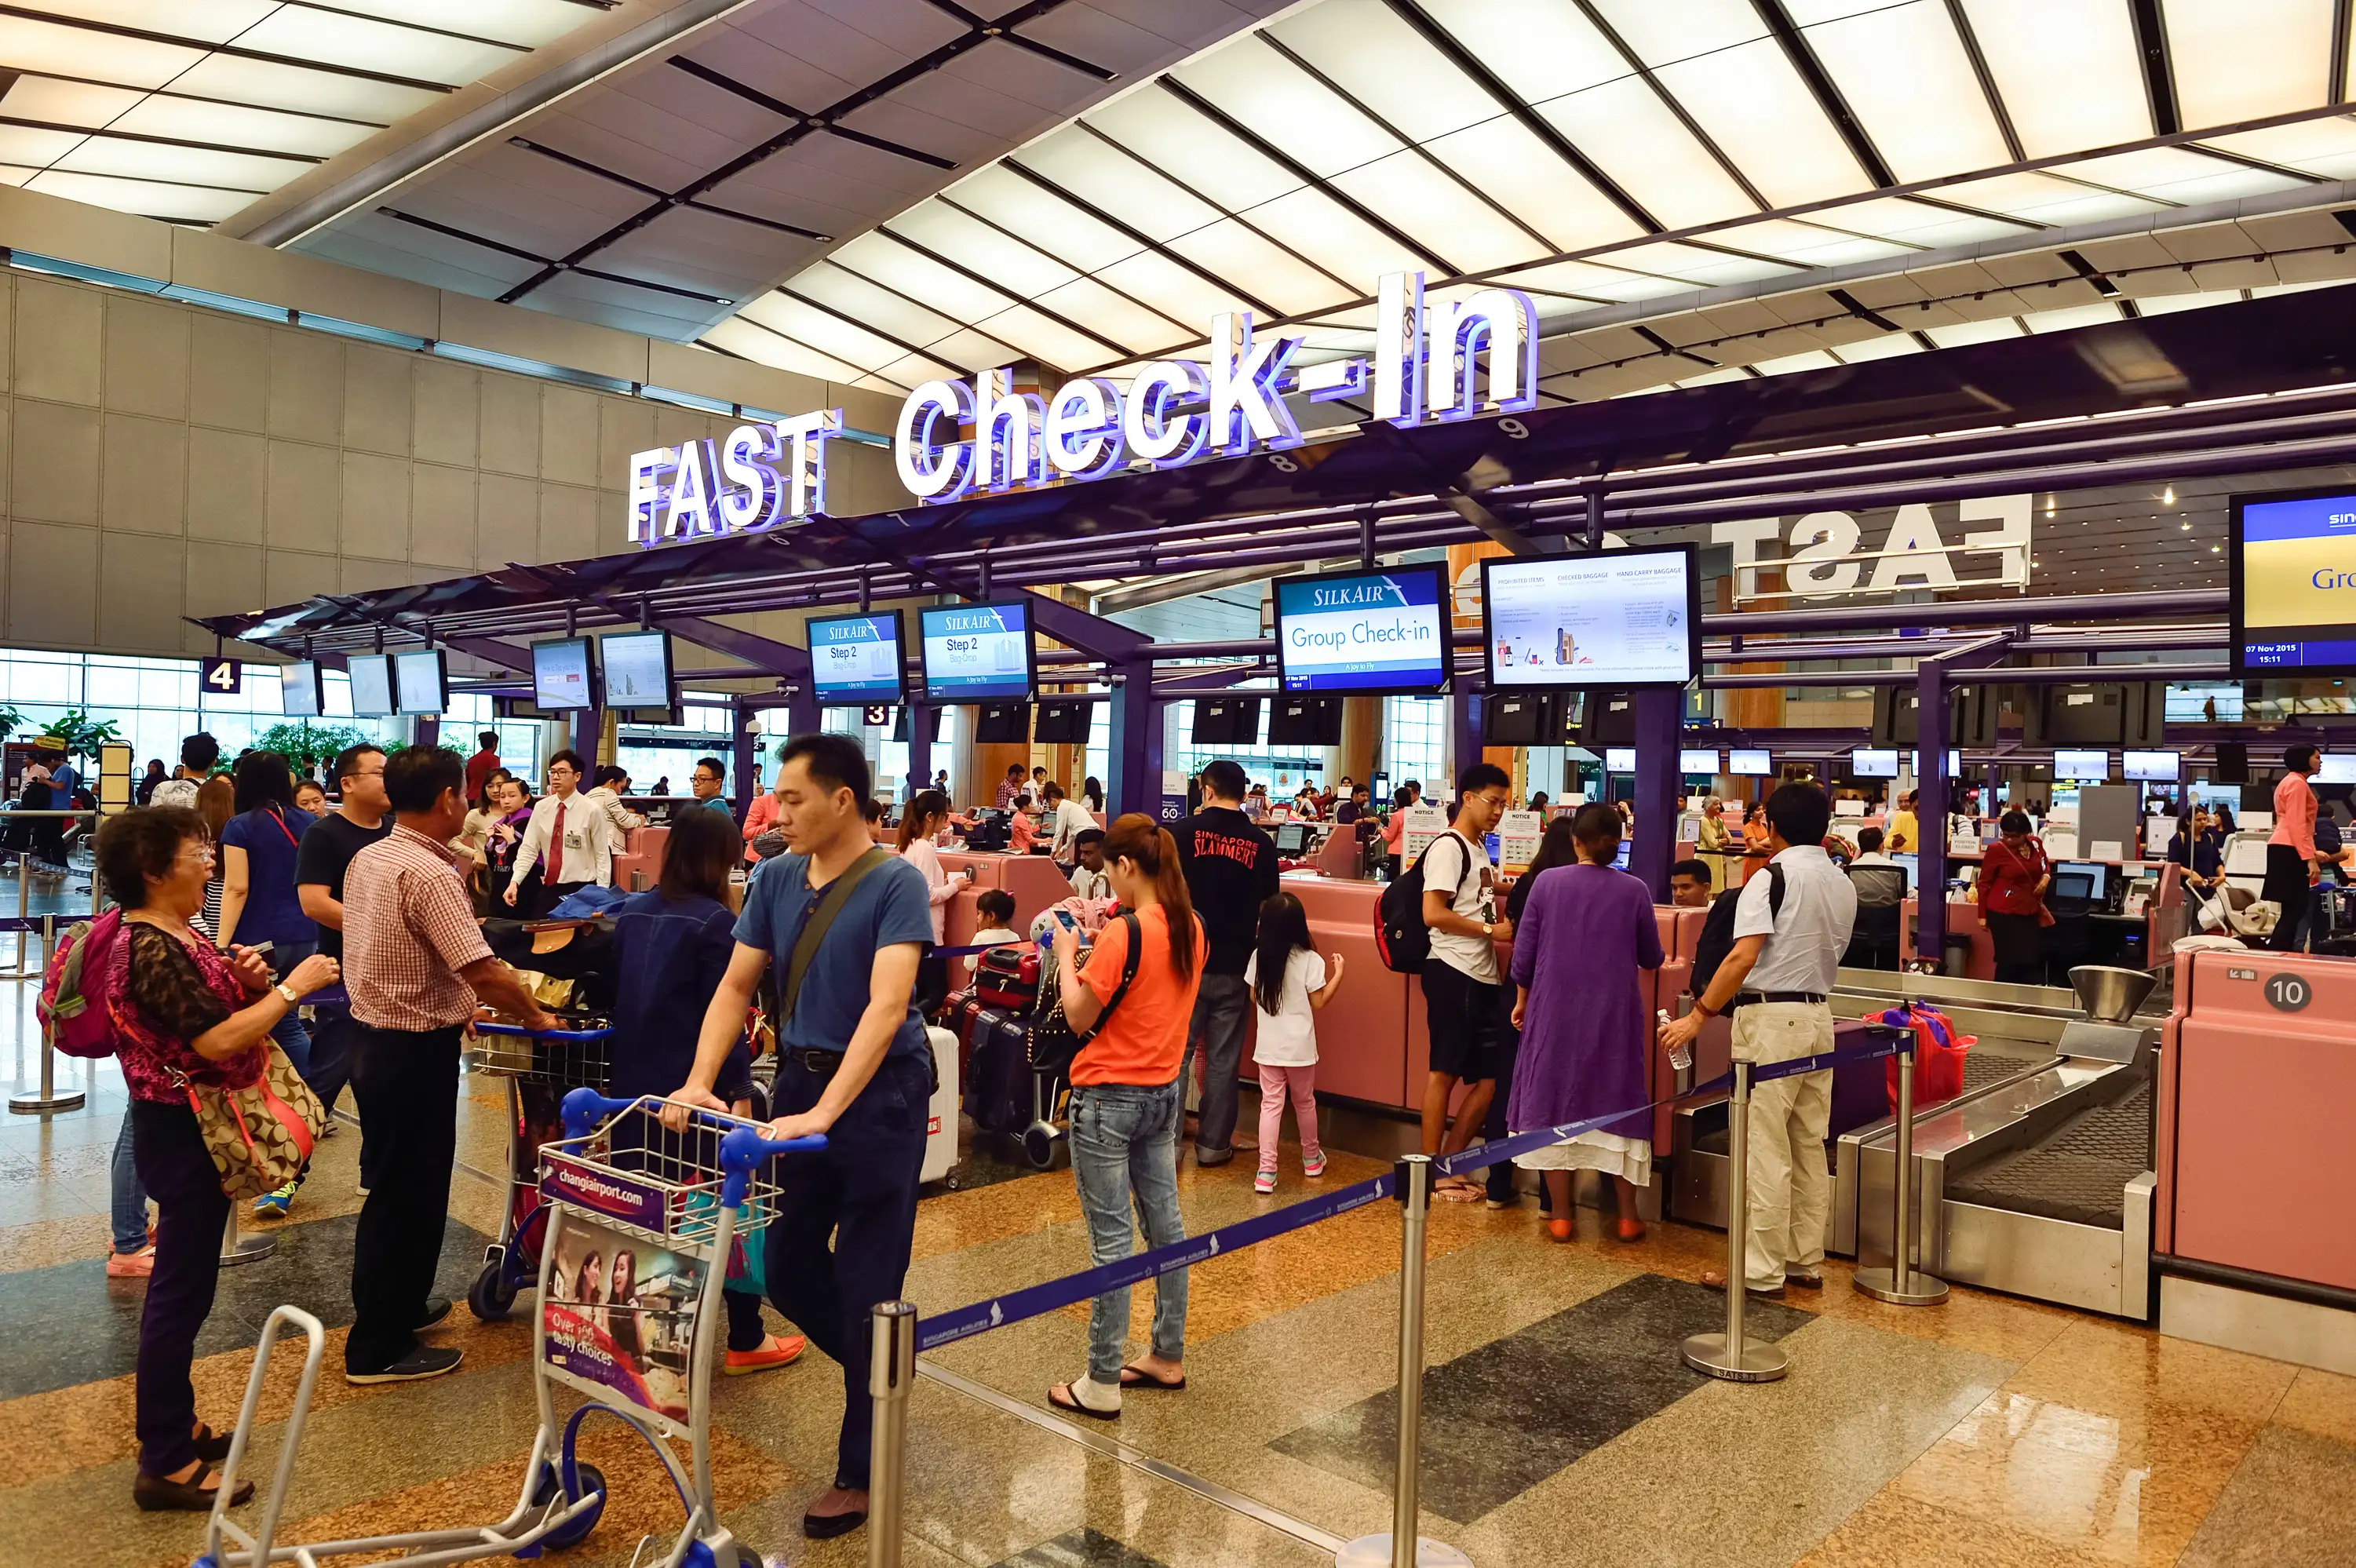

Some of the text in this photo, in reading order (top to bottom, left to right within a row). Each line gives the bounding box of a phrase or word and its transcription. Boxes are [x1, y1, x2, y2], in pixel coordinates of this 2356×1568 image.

[628, 272, 1538, 543] FAST Check-In
[1498, 418, 1530, 439] 9
[1268, 455, 1298, 472] 8
[886, 512, 910, 527] 7
[767, 533, 790, 546] 6
[1292, 618, 1430, 651] Group Check-in
[830, 646, 857, 660] Step 2
[946, 637, 978, 652] Step 2
[2257, 644, 2274, 653] Nov
[950, 654, 977, 664] Bag-Drop
[209, 662, 235, 690] 4
[1694, 692, 1702, 711] 1
[868, 706, 885, 724] 3
[1712, 720, 1720, 729] 1
[1162, 808, 1178, 819] 60
[1194, 830, 1259, 849] SINGAPORE
[1194, 838, 1256, 870] SLAMMERS
[966, 867, 972, 879] 7
[2273, 980, 2303, 1005] 10
[559, 1169, 643, 1206] changiairport.com
[553, 1312, 575, 1333] Over
[553, 1330, 612, 1366] tasty choices
